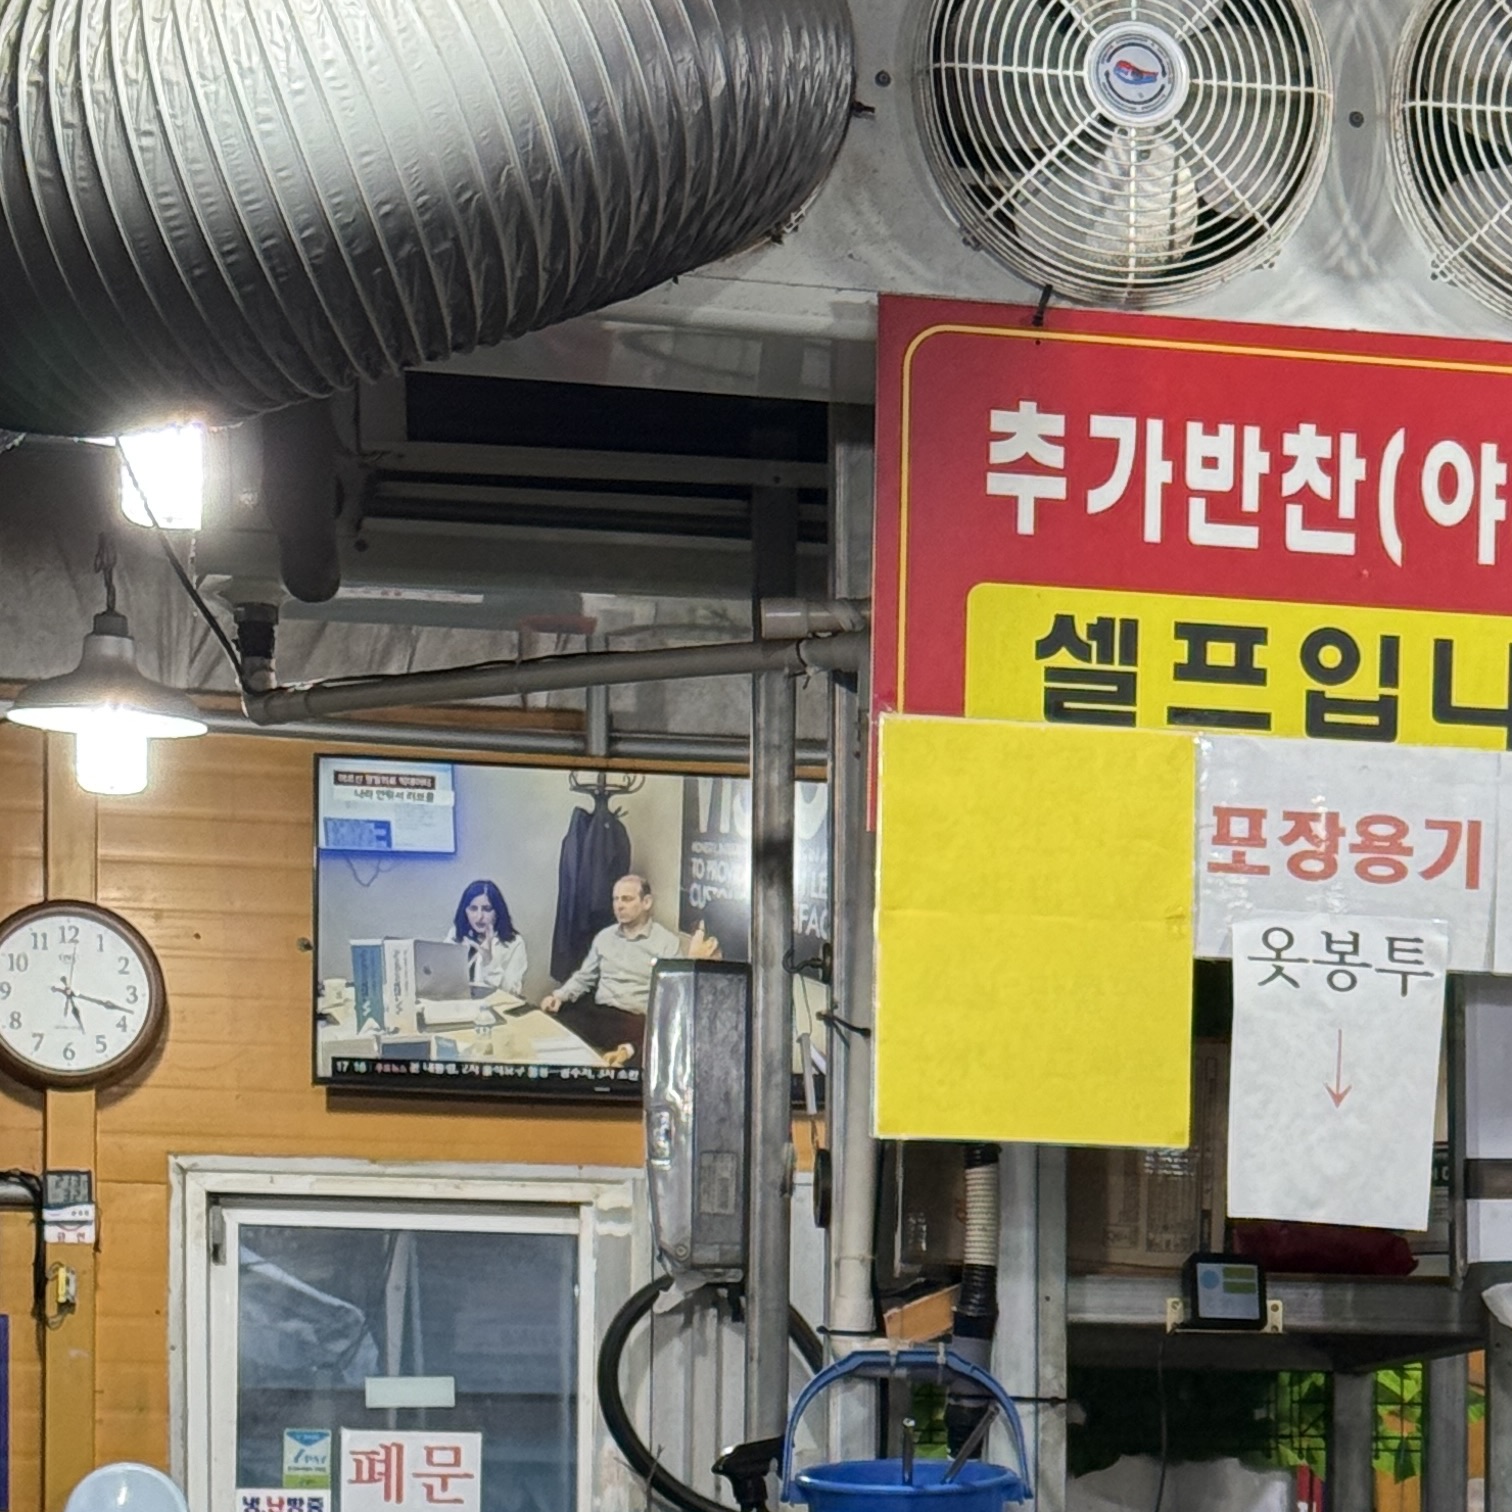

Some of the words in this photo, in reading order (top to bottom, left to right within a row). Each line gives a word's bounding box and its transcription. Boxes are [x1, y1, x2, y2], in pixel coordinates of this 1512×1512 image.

[1206, 805, 1483, 891] 포장용기
[31, 932, 48, 950] 11
[58, 925, 80, 944] 12
[97, 934, 104, 952] 1
[8, 952, 28, 972] 10
[118, 956, 130, 975] 2
[1247, 926, 1434, 998] 옷봉투
[0, 981, 12, 1000] 9
[126, 985, 139, 1004] 3
[9, 1011, 22, 1029] 8
[116, 1015, 128, 1032] 4
[32, 1033, 44, 1051] 7
[63, 1042, 76, 1061] 6
[95, 1035, 107, 1053] 5
[347, 1442, 475, 1504] 폐문
